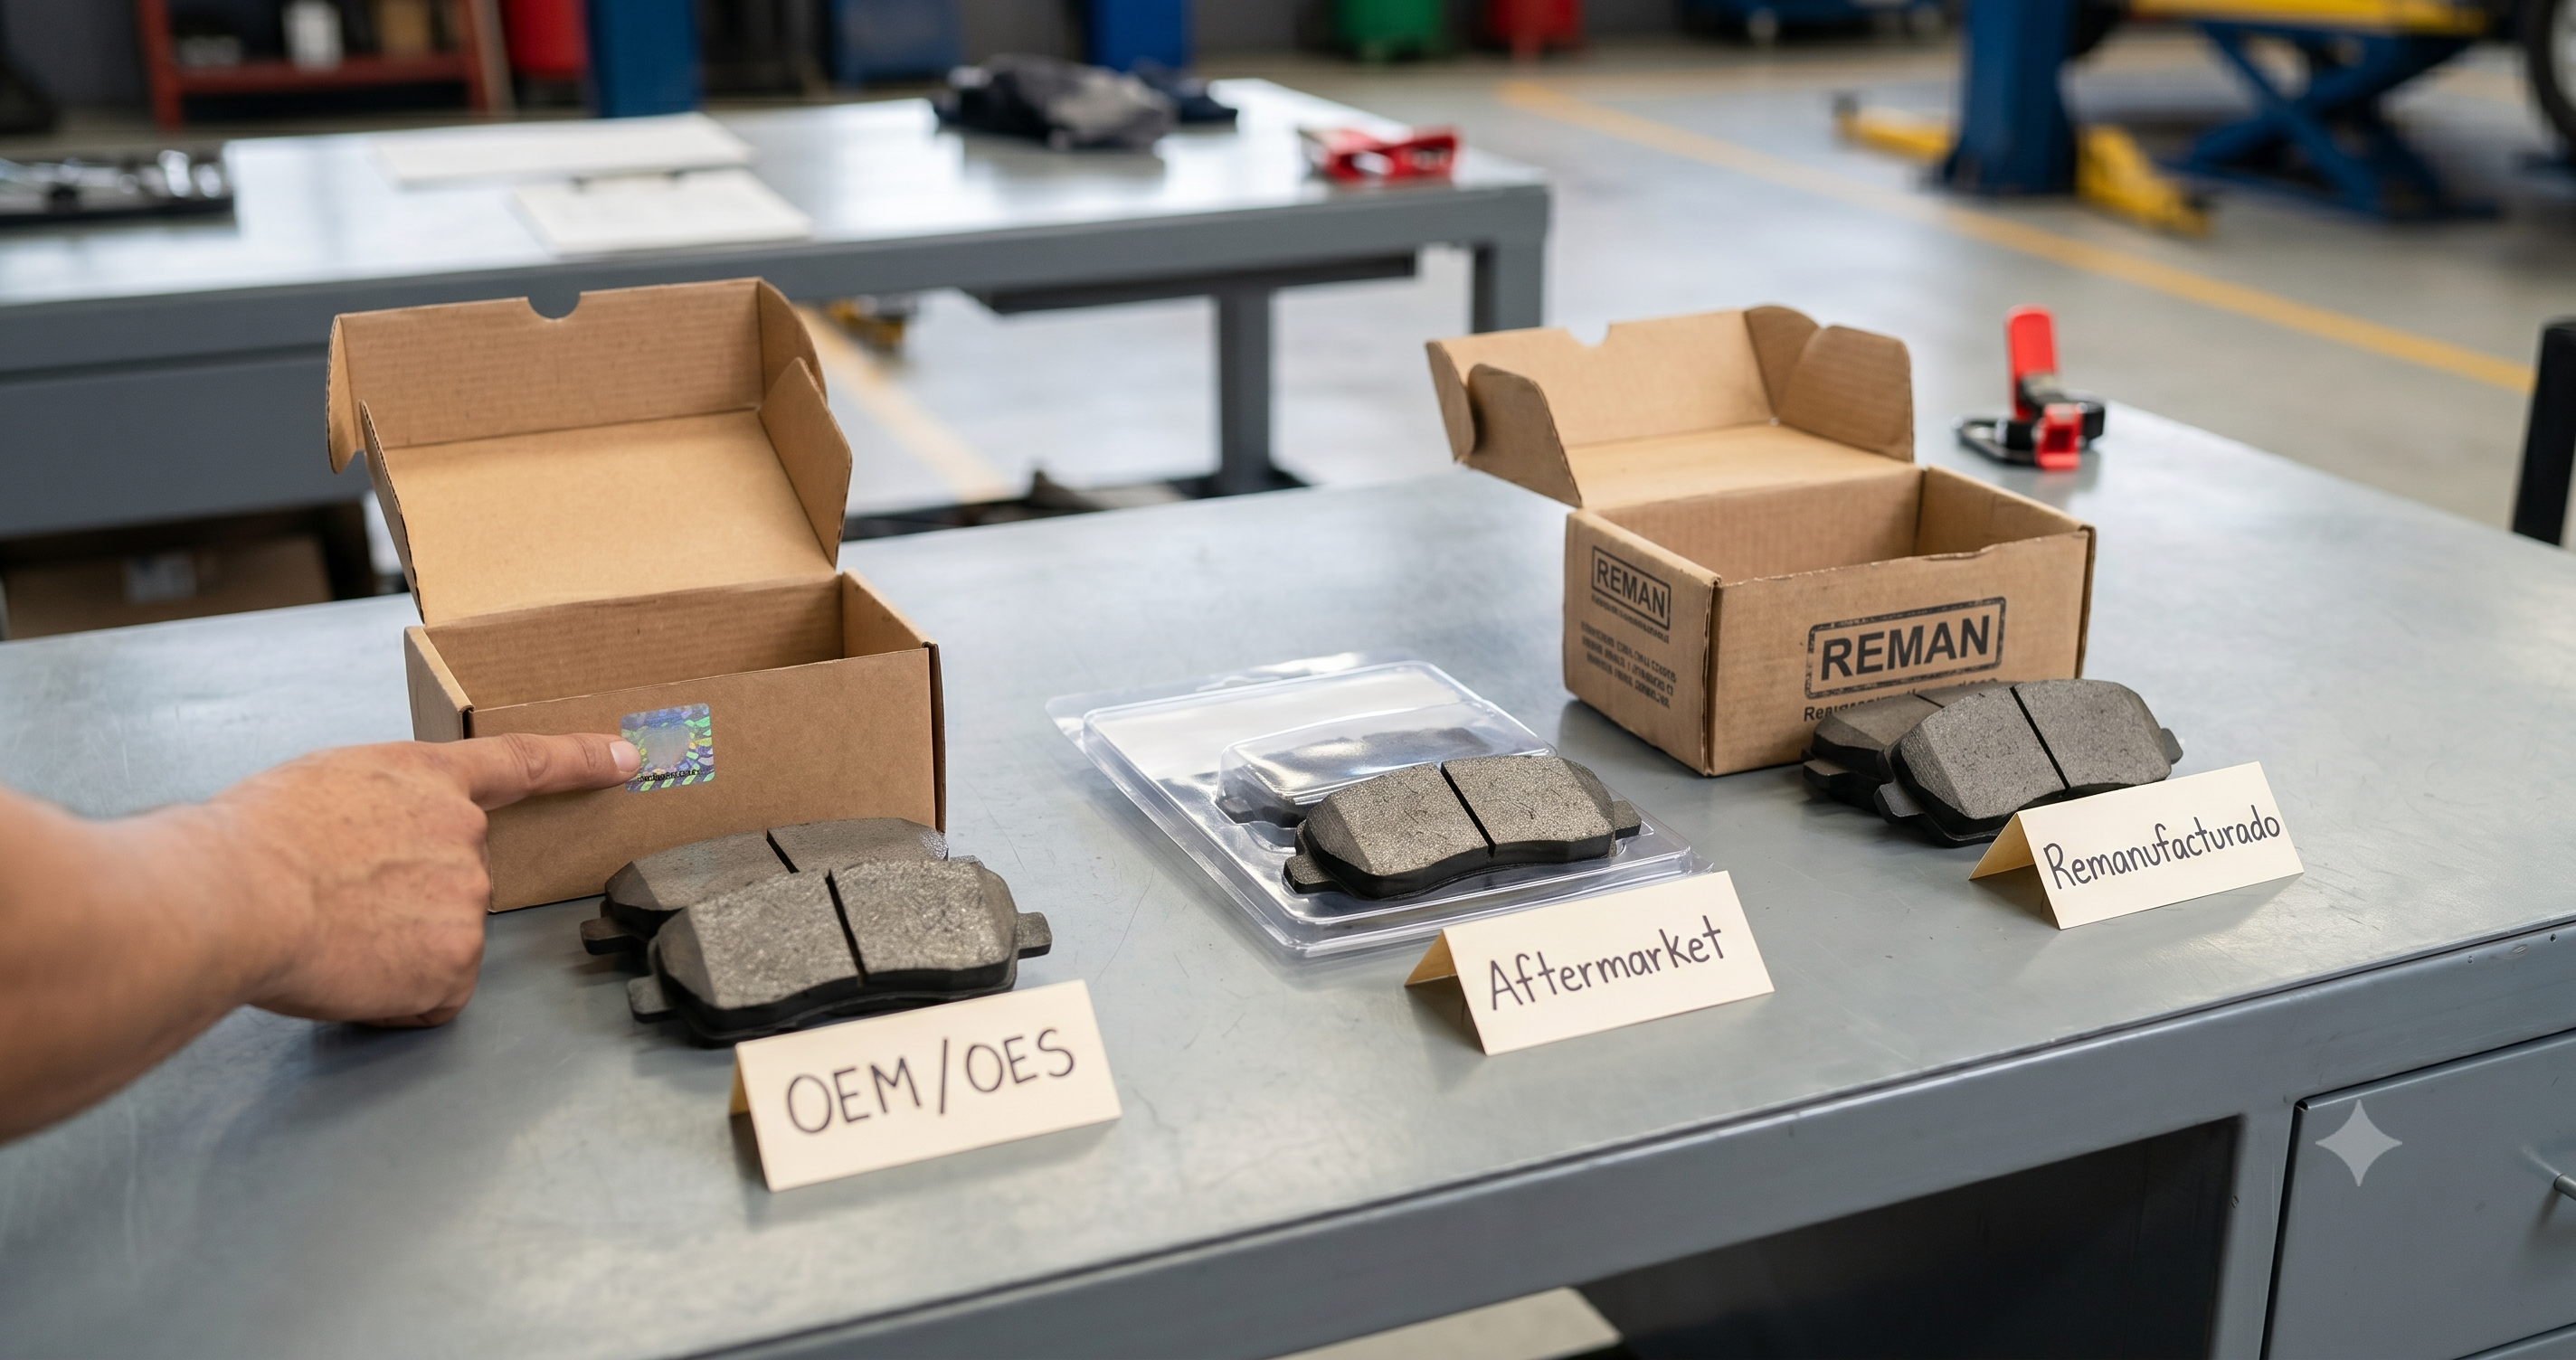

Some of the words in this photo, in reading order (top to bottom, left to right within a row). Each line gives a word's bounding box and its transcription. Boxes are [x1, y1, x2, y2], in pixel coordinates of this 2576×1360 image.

[1597, 557, 1665, 619] REMAN
[1821, 615, 1989, 682] REMAN
[2043, 804, 2281, 890] Remanufacturado
[1489, 914, 1725, 1011] Aftermarket
